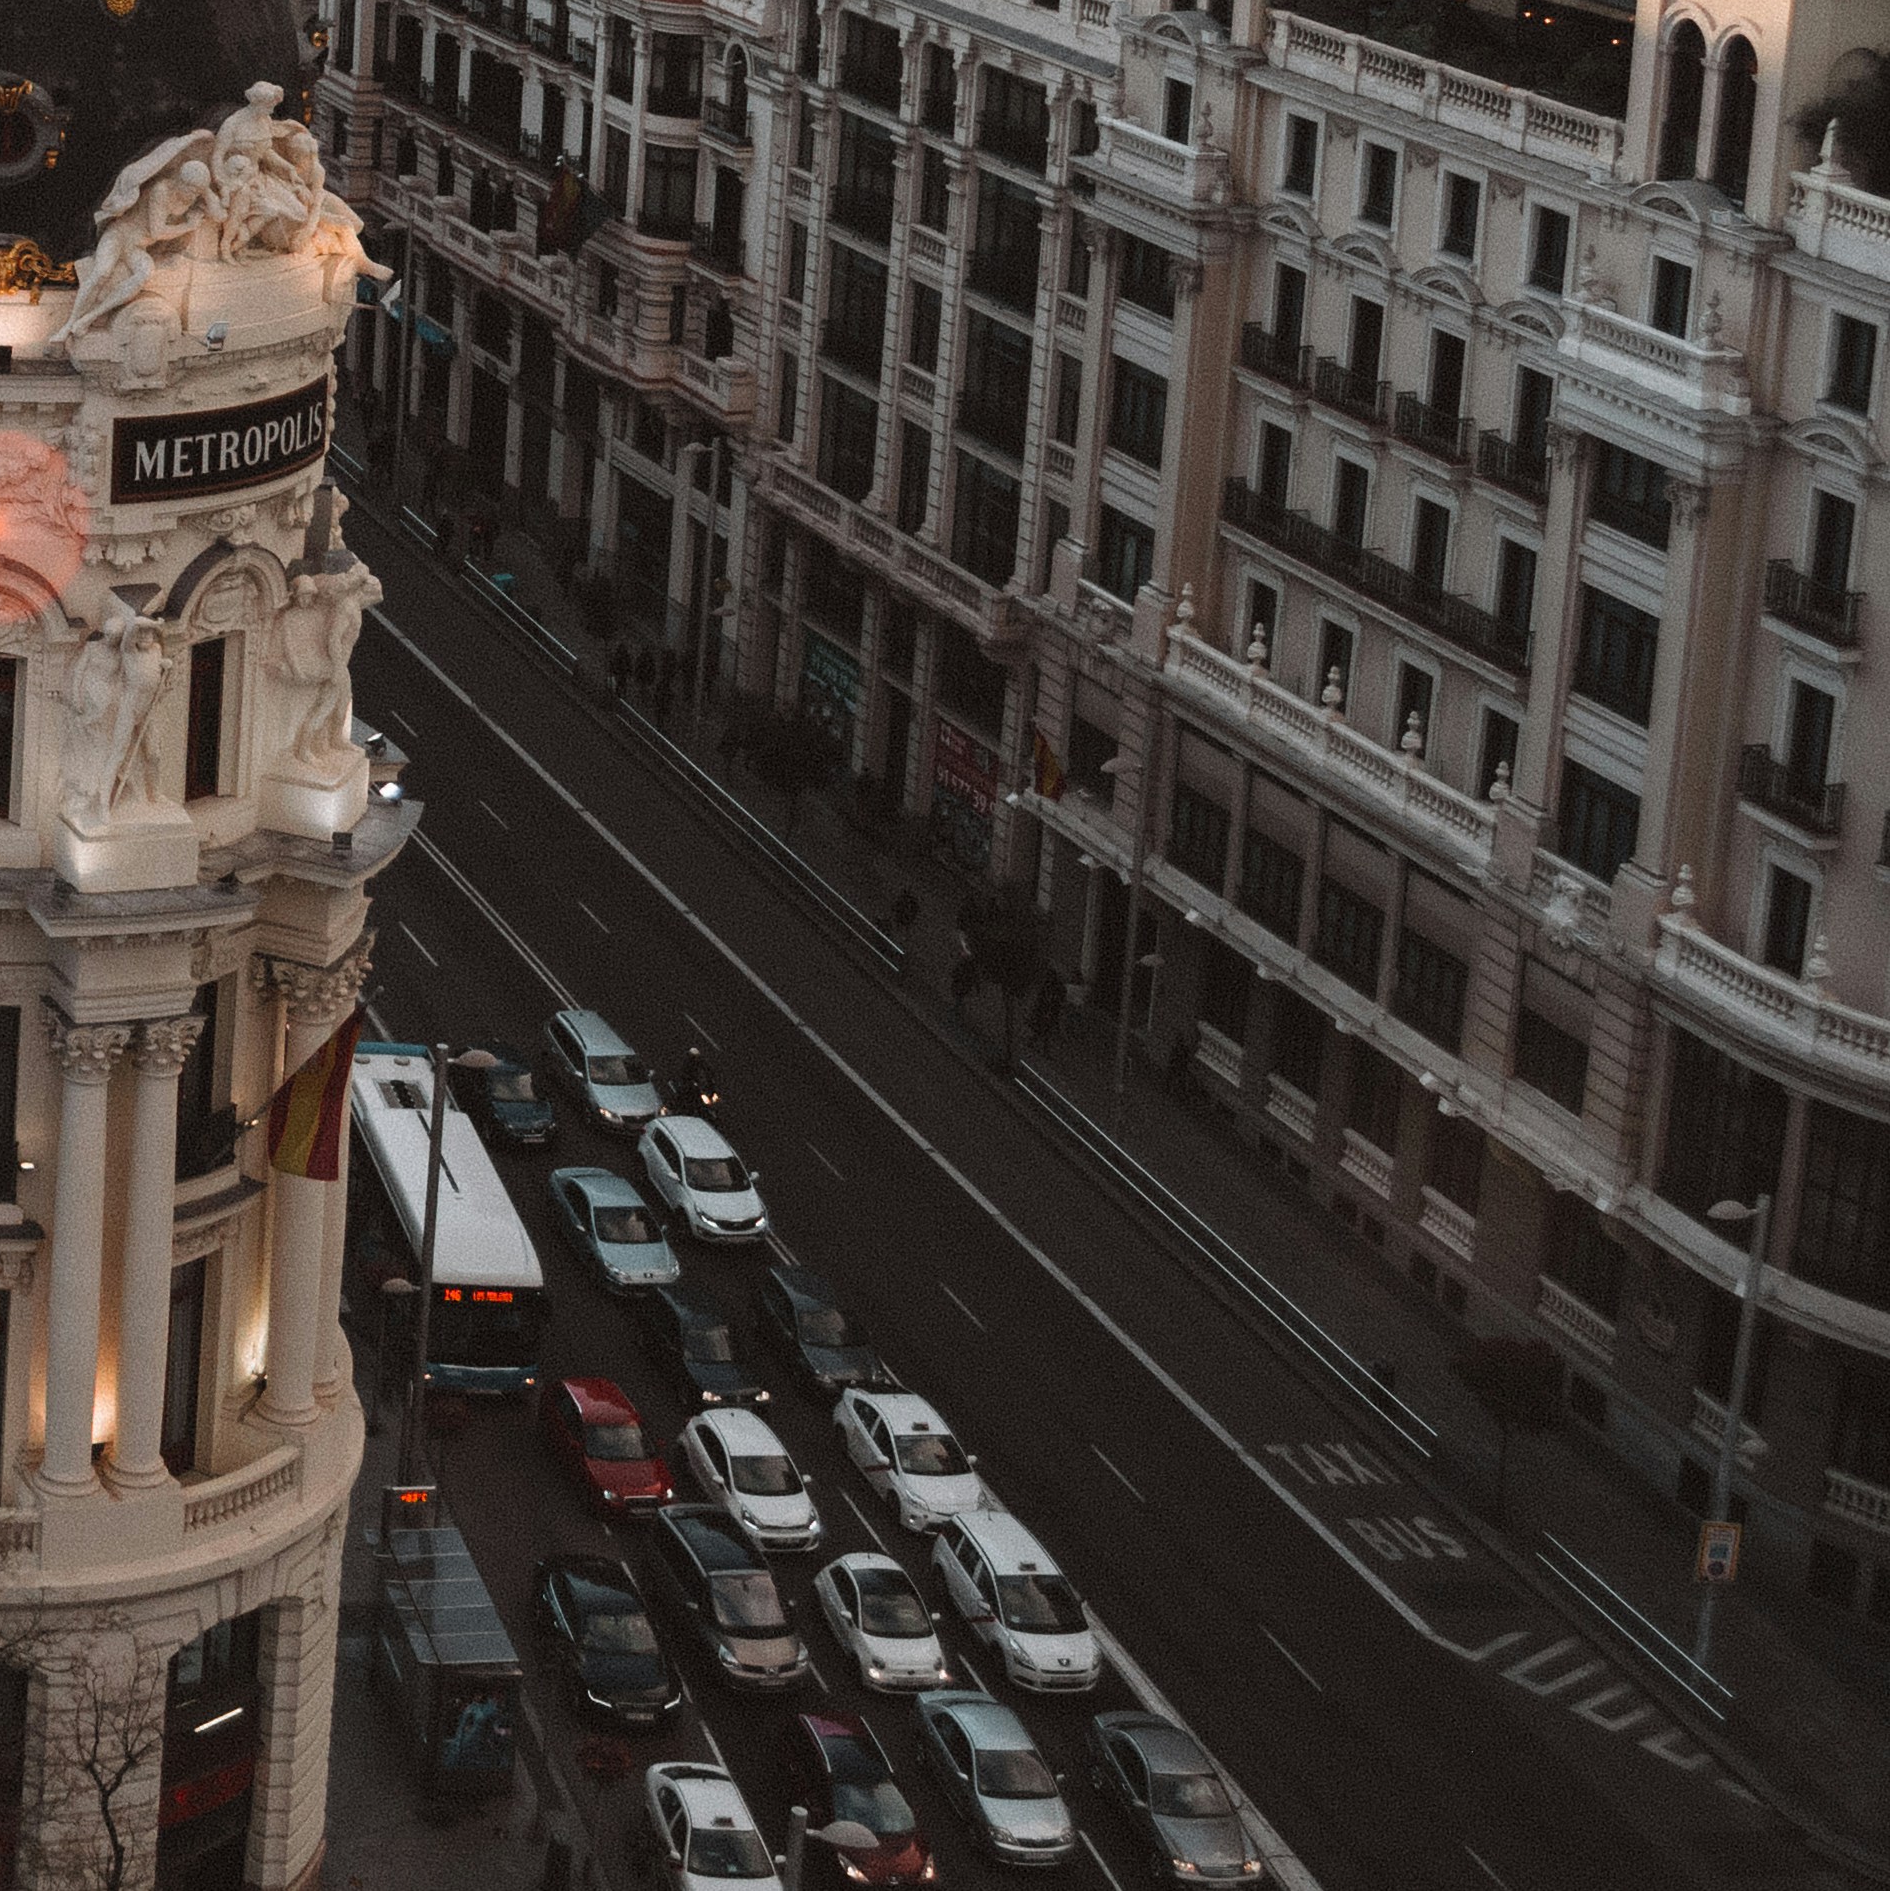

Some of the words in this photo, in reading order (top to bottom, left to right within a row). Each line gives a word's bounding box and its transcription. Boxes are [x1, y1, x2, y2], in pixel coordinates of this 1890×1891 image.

[133, 401, 323, 482] METROPOLIS
[1263, 1442, 1401, 1485] TAXI
[1344, 1515, 1468, 1560] BUS
